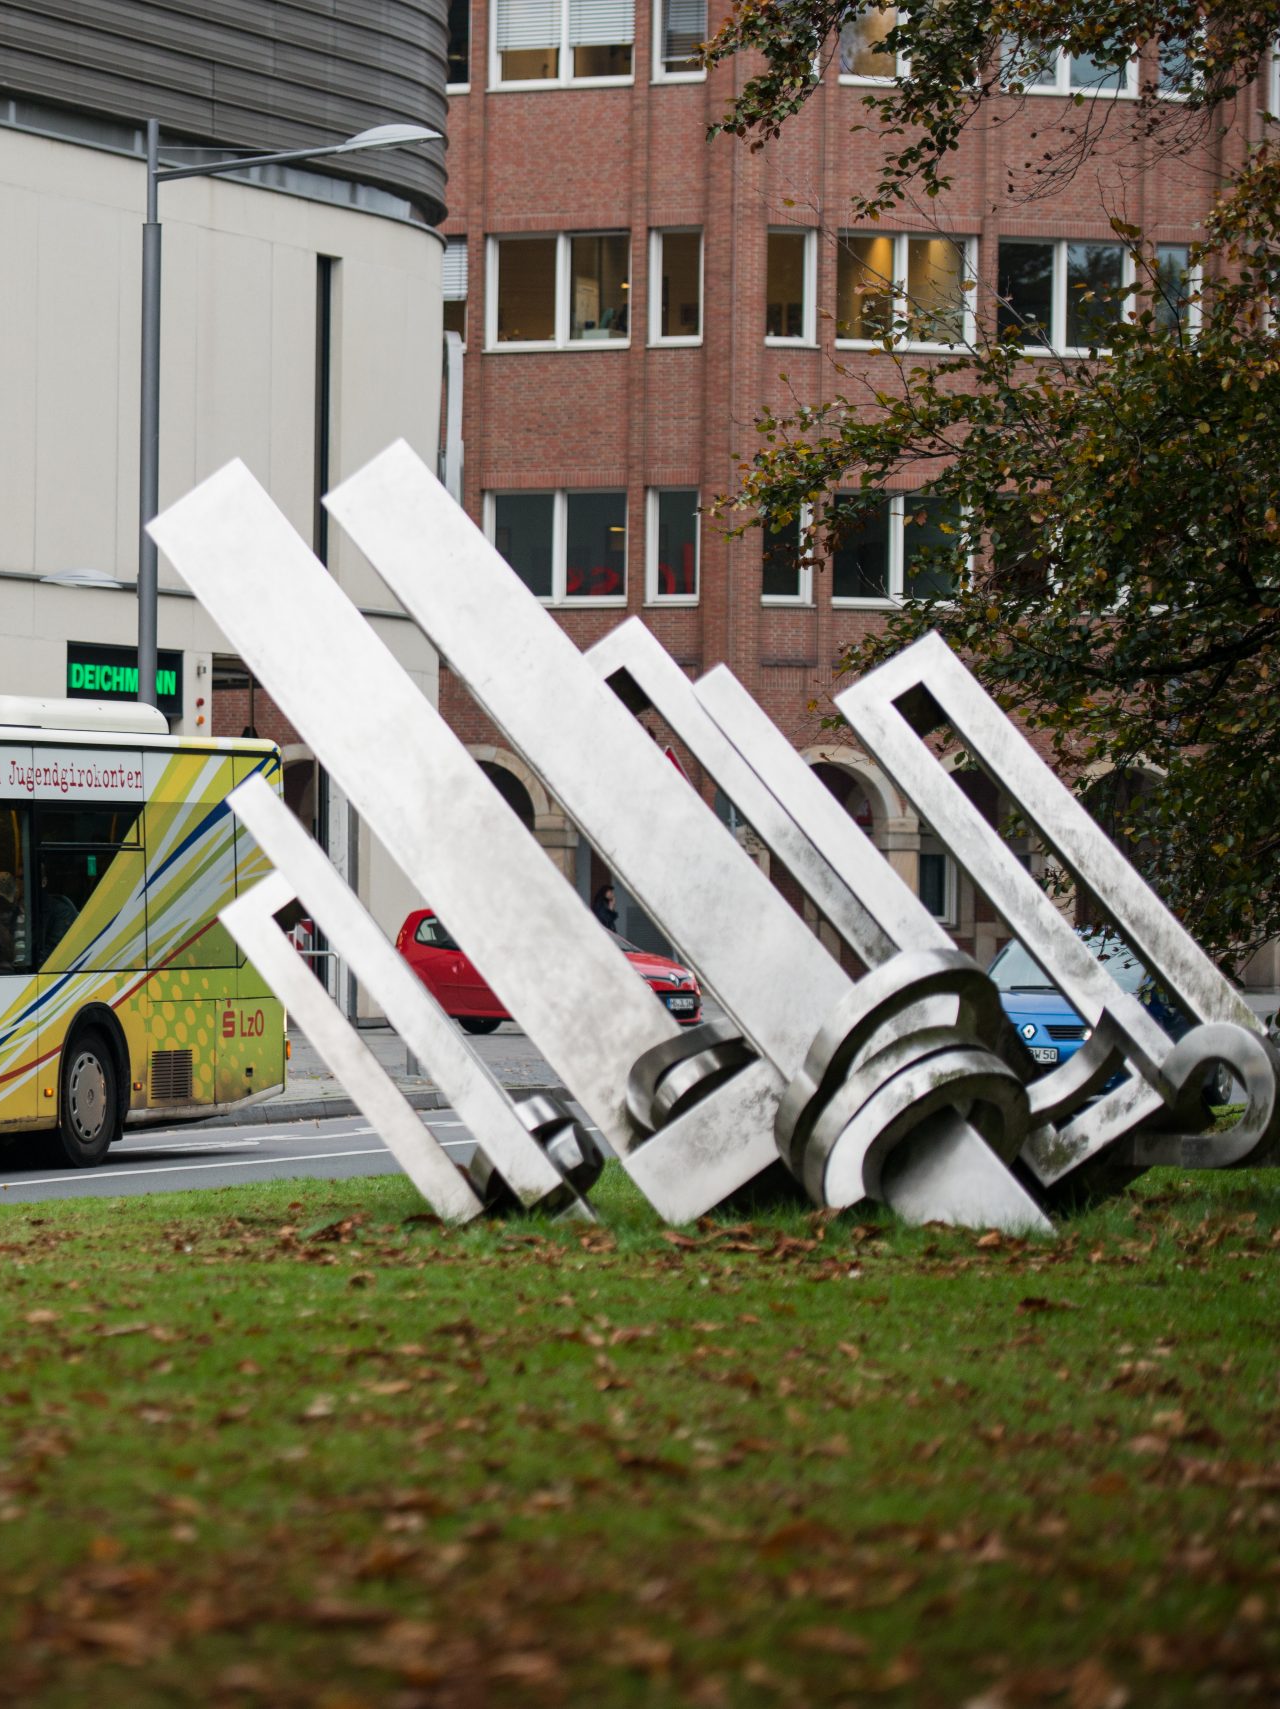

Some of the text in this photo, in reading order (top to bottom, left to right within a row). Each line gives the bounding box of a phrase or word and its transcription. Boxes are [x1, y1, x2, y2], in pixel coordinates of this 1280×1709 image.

[71, 663, 177, 695] DEICHMNN
[9, 760, 144, 793] Jugendgirokonten
[240, 1008, 264, 1037] LzO
